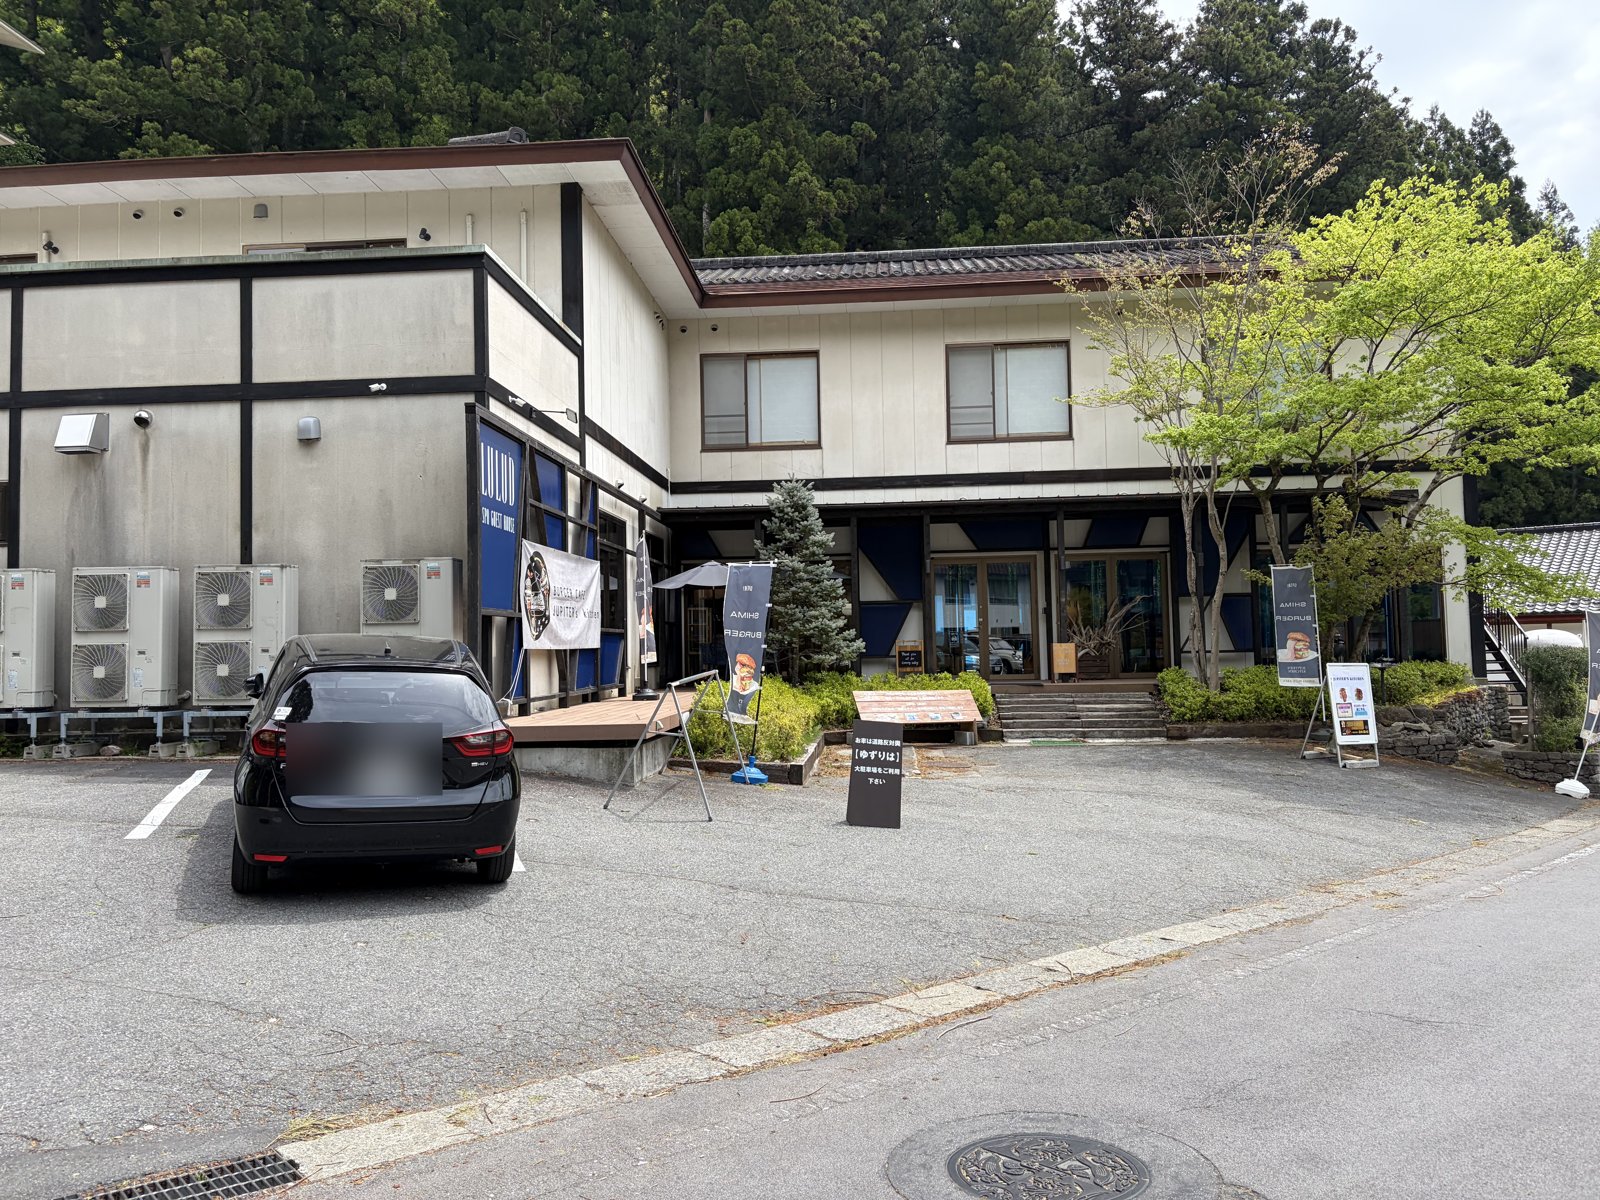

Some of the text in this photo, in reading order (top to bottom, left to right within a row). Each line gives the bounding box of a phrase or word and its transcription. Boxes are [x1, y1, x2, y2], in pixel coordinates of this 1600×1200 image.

[482, 507, 515, 534] SPA GUEST HOUSE
[854, 765, 901, 776] 大駐車場をご利用
[867, 777, 886, 785] 下さい
